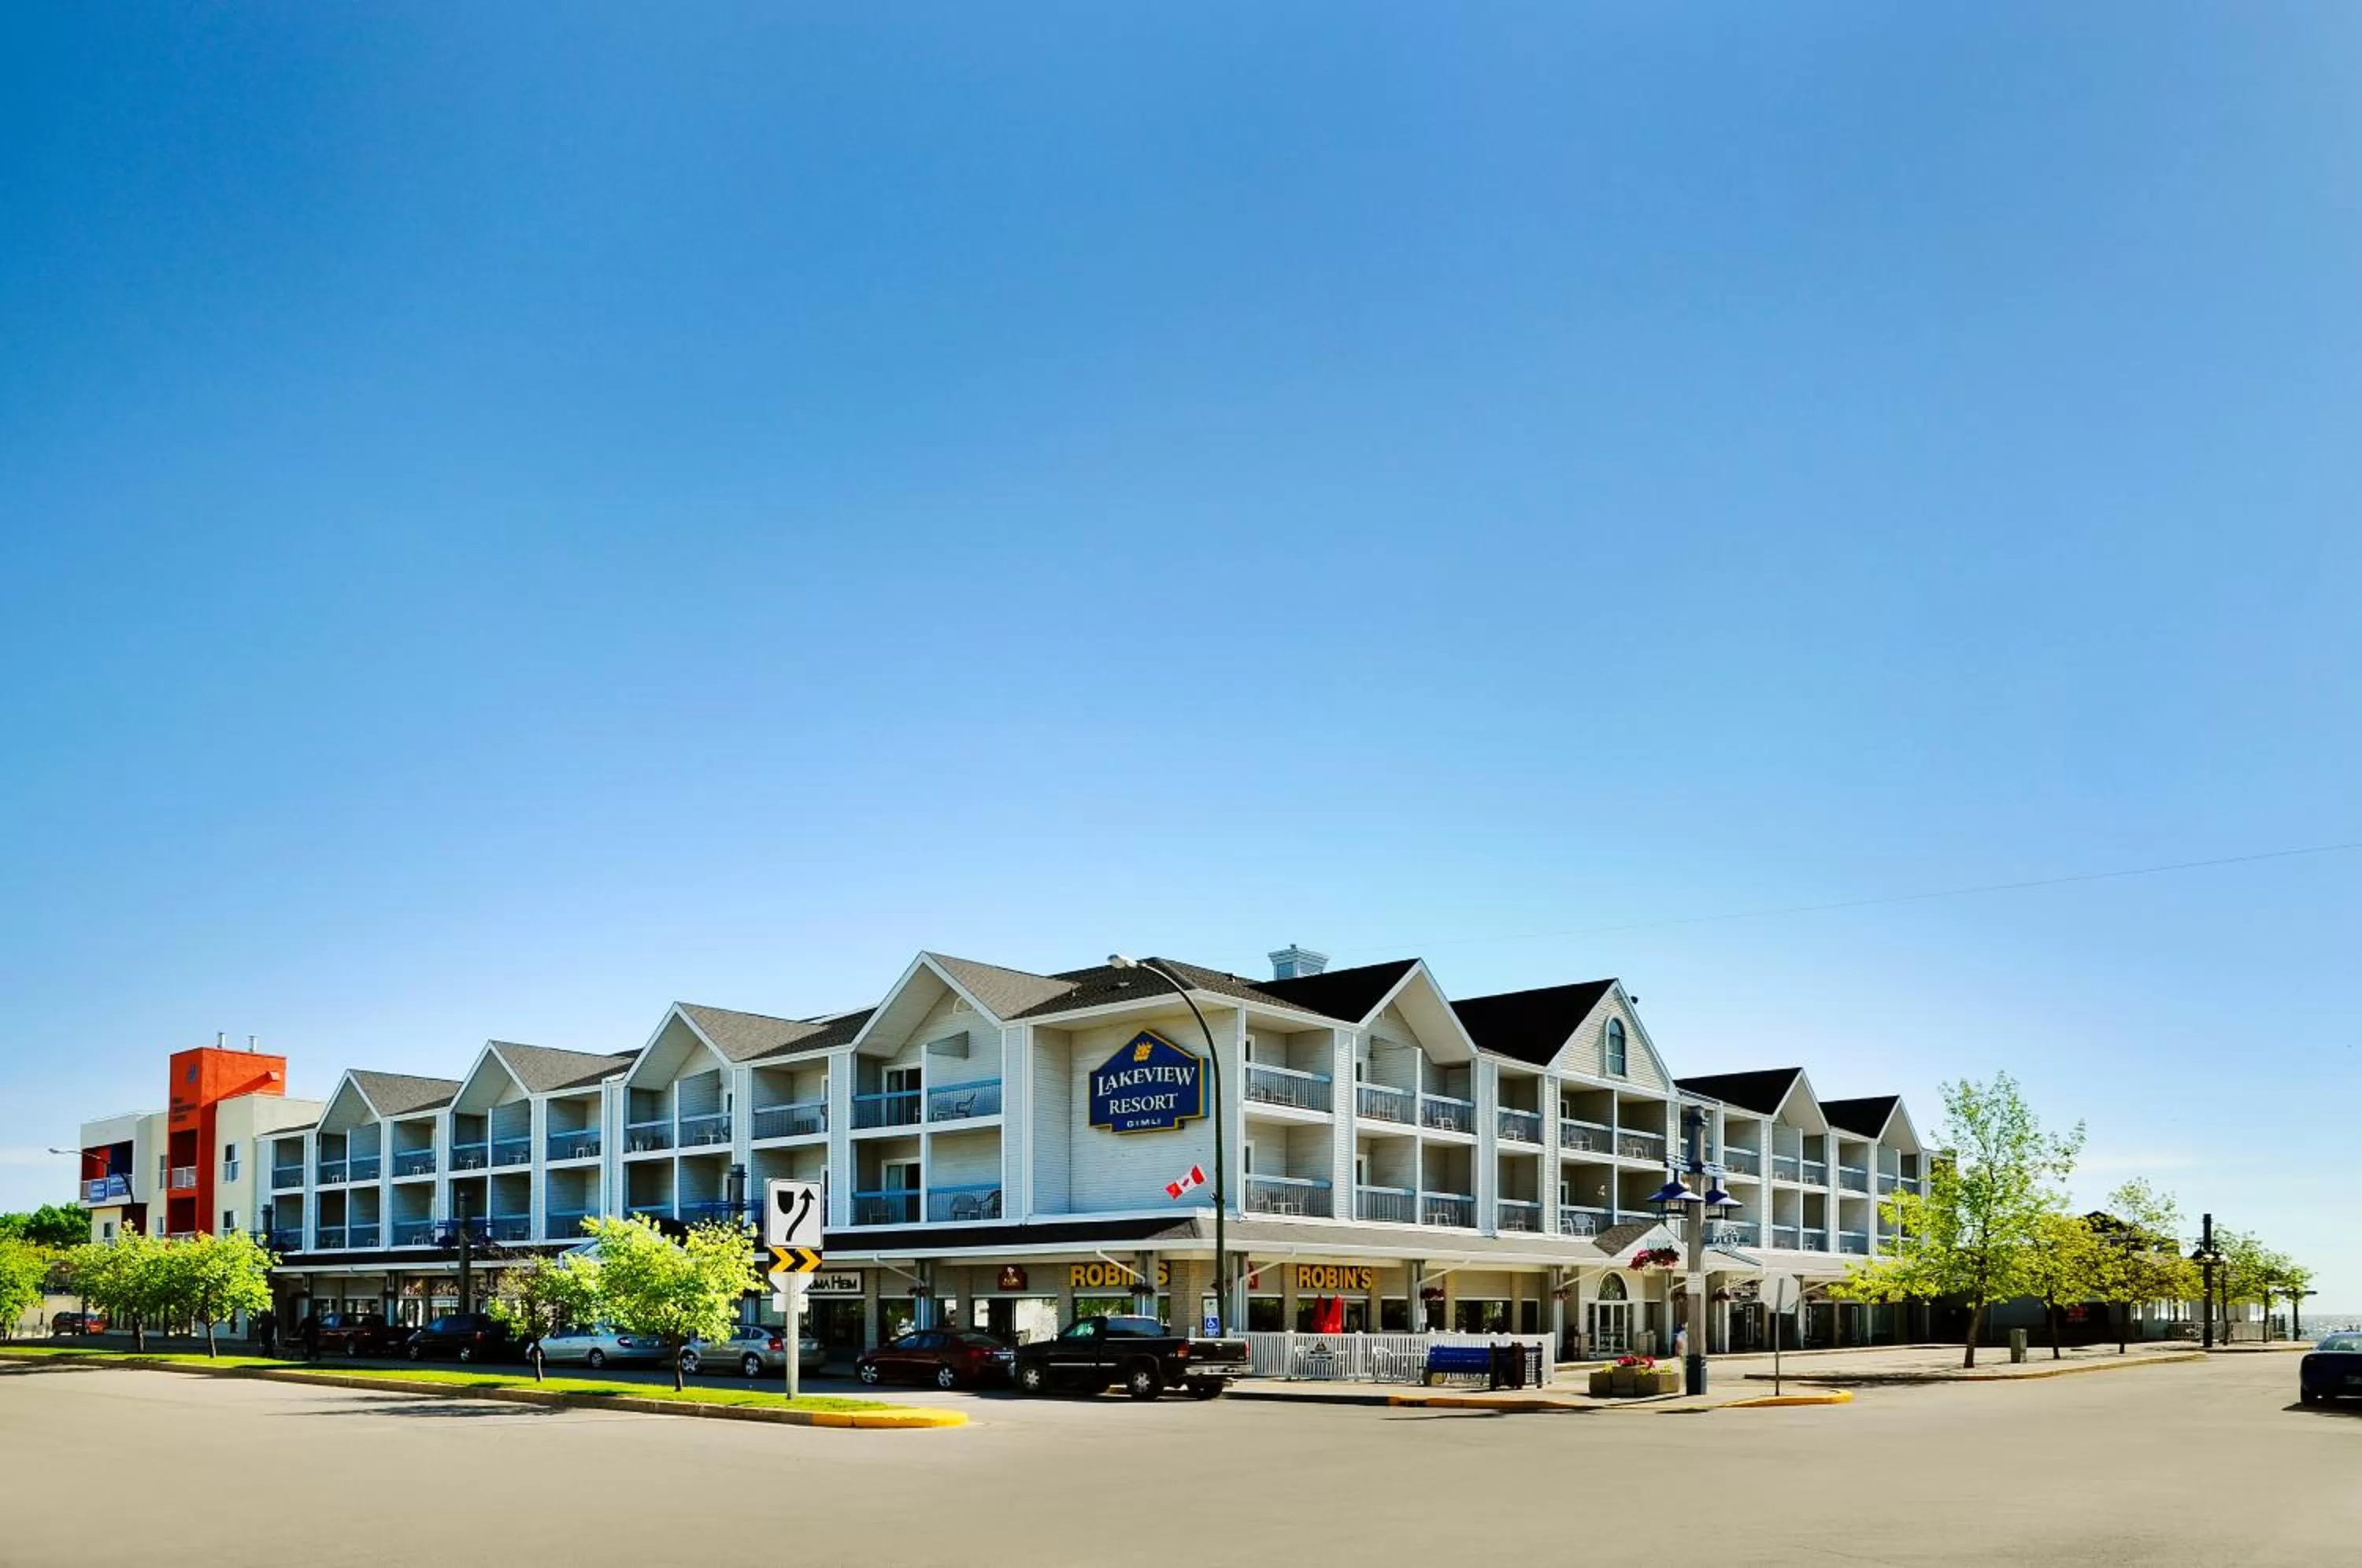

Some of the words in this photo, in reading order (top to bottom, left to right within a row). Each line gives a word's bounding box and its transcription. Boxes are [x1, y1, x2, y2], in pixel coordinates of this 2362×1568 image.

[1098, 1067, 1195, 1096] LAKEVIEW
[1109, 1092, 1179, 1115] RESORT
[1127, 1118, 1161, 1128] GIMLI
[1071, 1262, 1168, 1286] ROBIS
[1298, 1265, 1373, 1289] ROBIN'S
